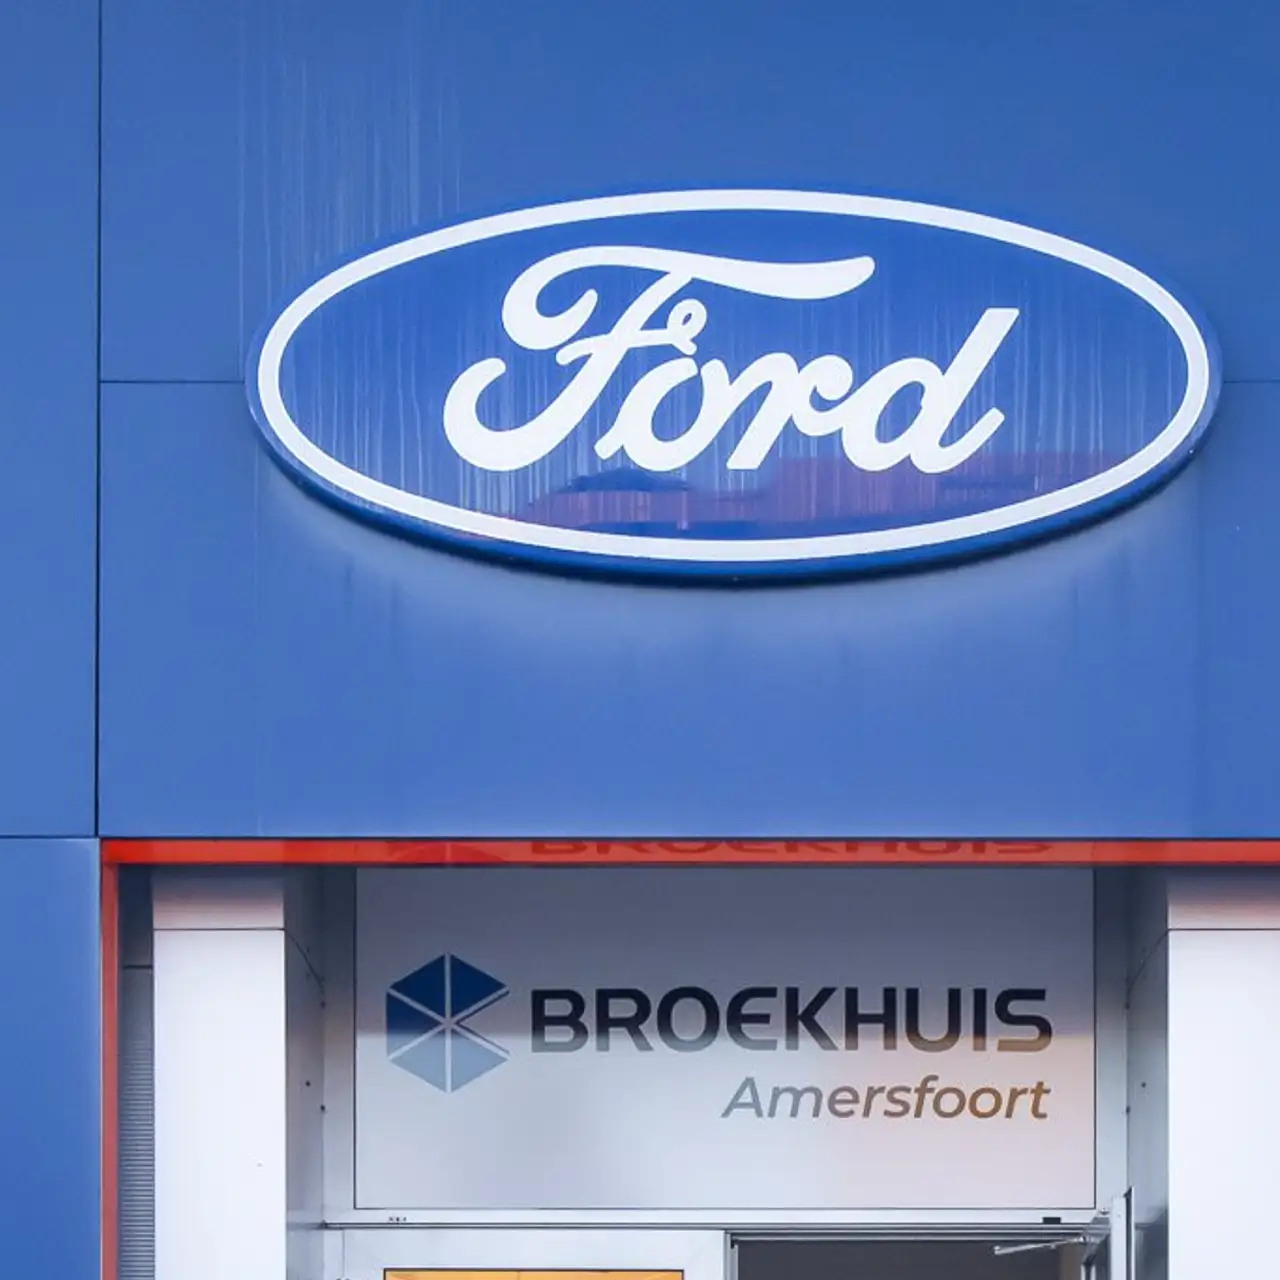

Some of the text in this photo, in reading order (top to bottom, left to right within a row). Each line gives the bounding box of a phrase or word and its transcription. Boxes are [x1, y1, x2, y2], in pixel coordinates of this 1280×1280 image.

[442, 245, 1020, 475] Ford
[530, 985, 1053, 1053] BROEKHUIS
[721, 1075, 1052, 1119] Amersfoort
